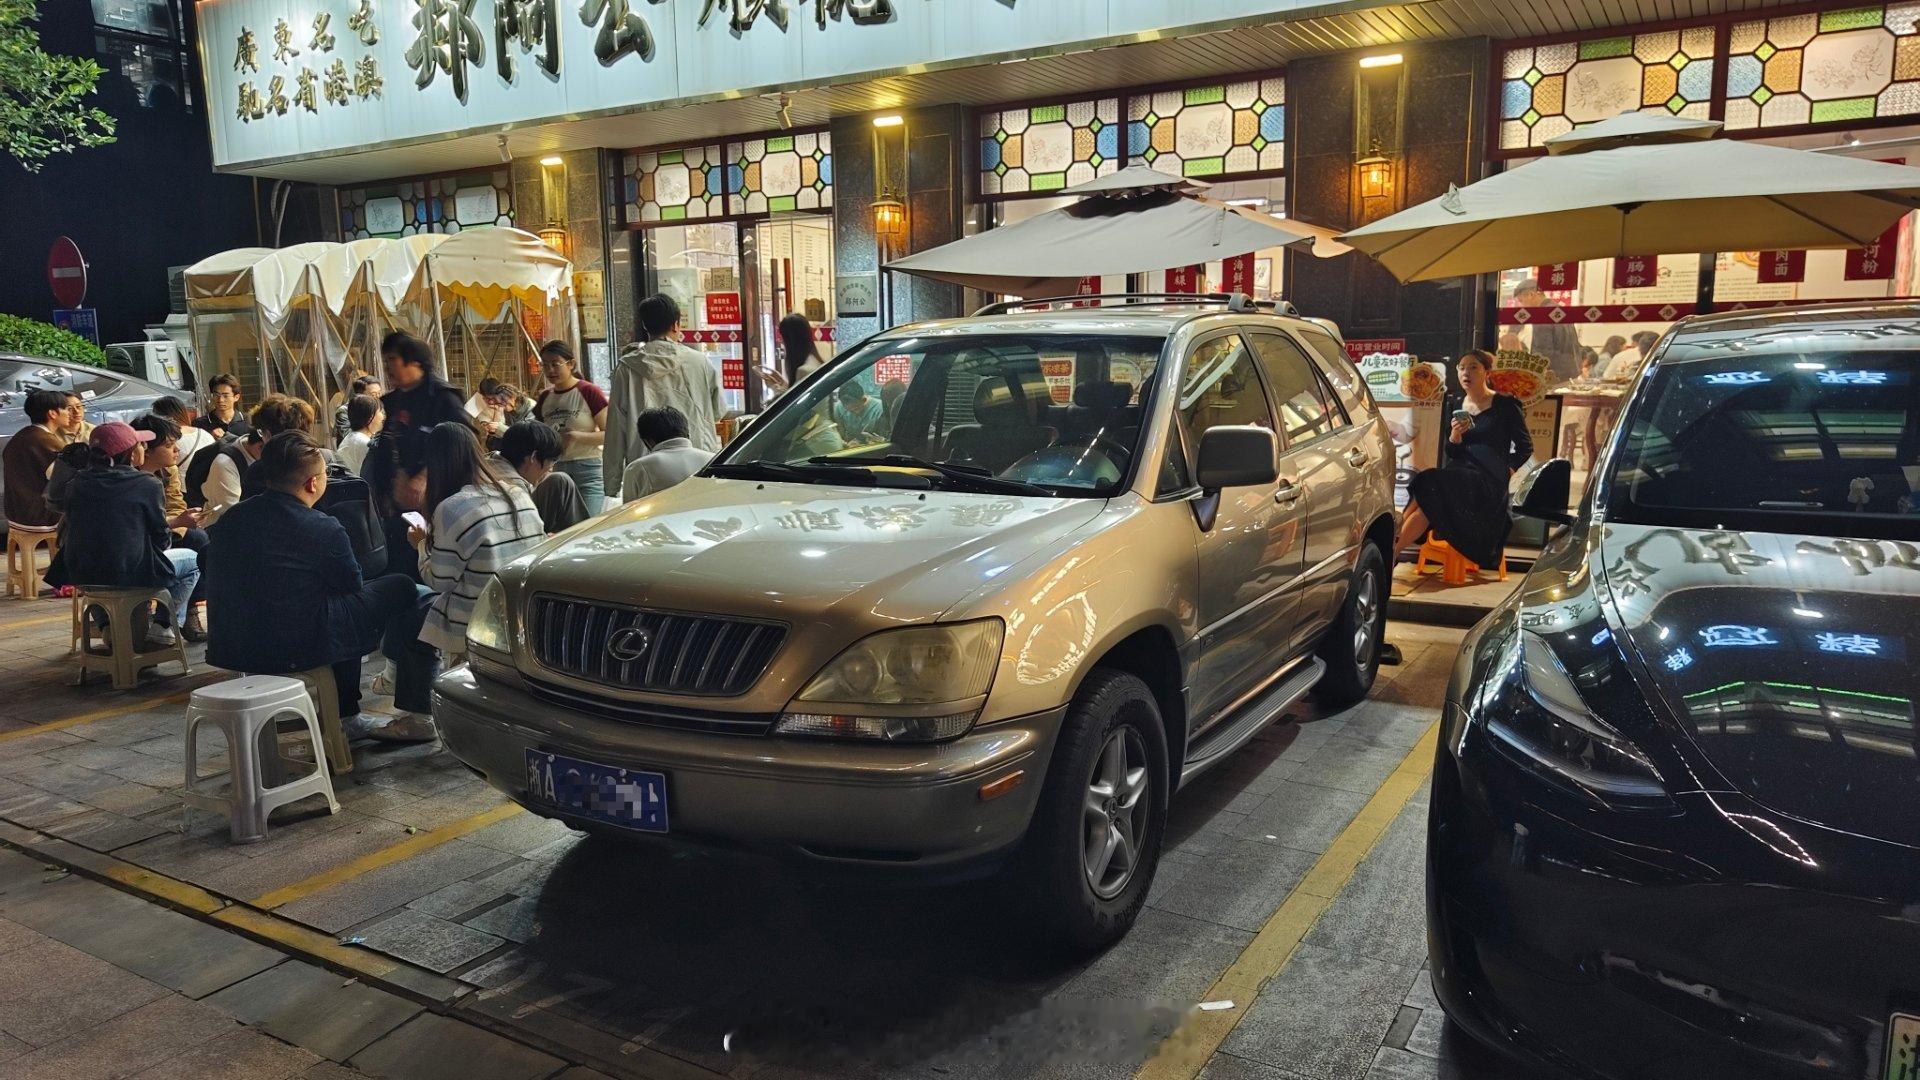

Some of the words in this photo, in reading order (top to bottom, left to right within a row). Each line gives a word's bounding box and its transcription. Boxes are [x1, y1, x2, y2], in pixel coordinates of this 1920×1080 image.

[1362, 355, 1415, 369] 儿童友好餐厅
